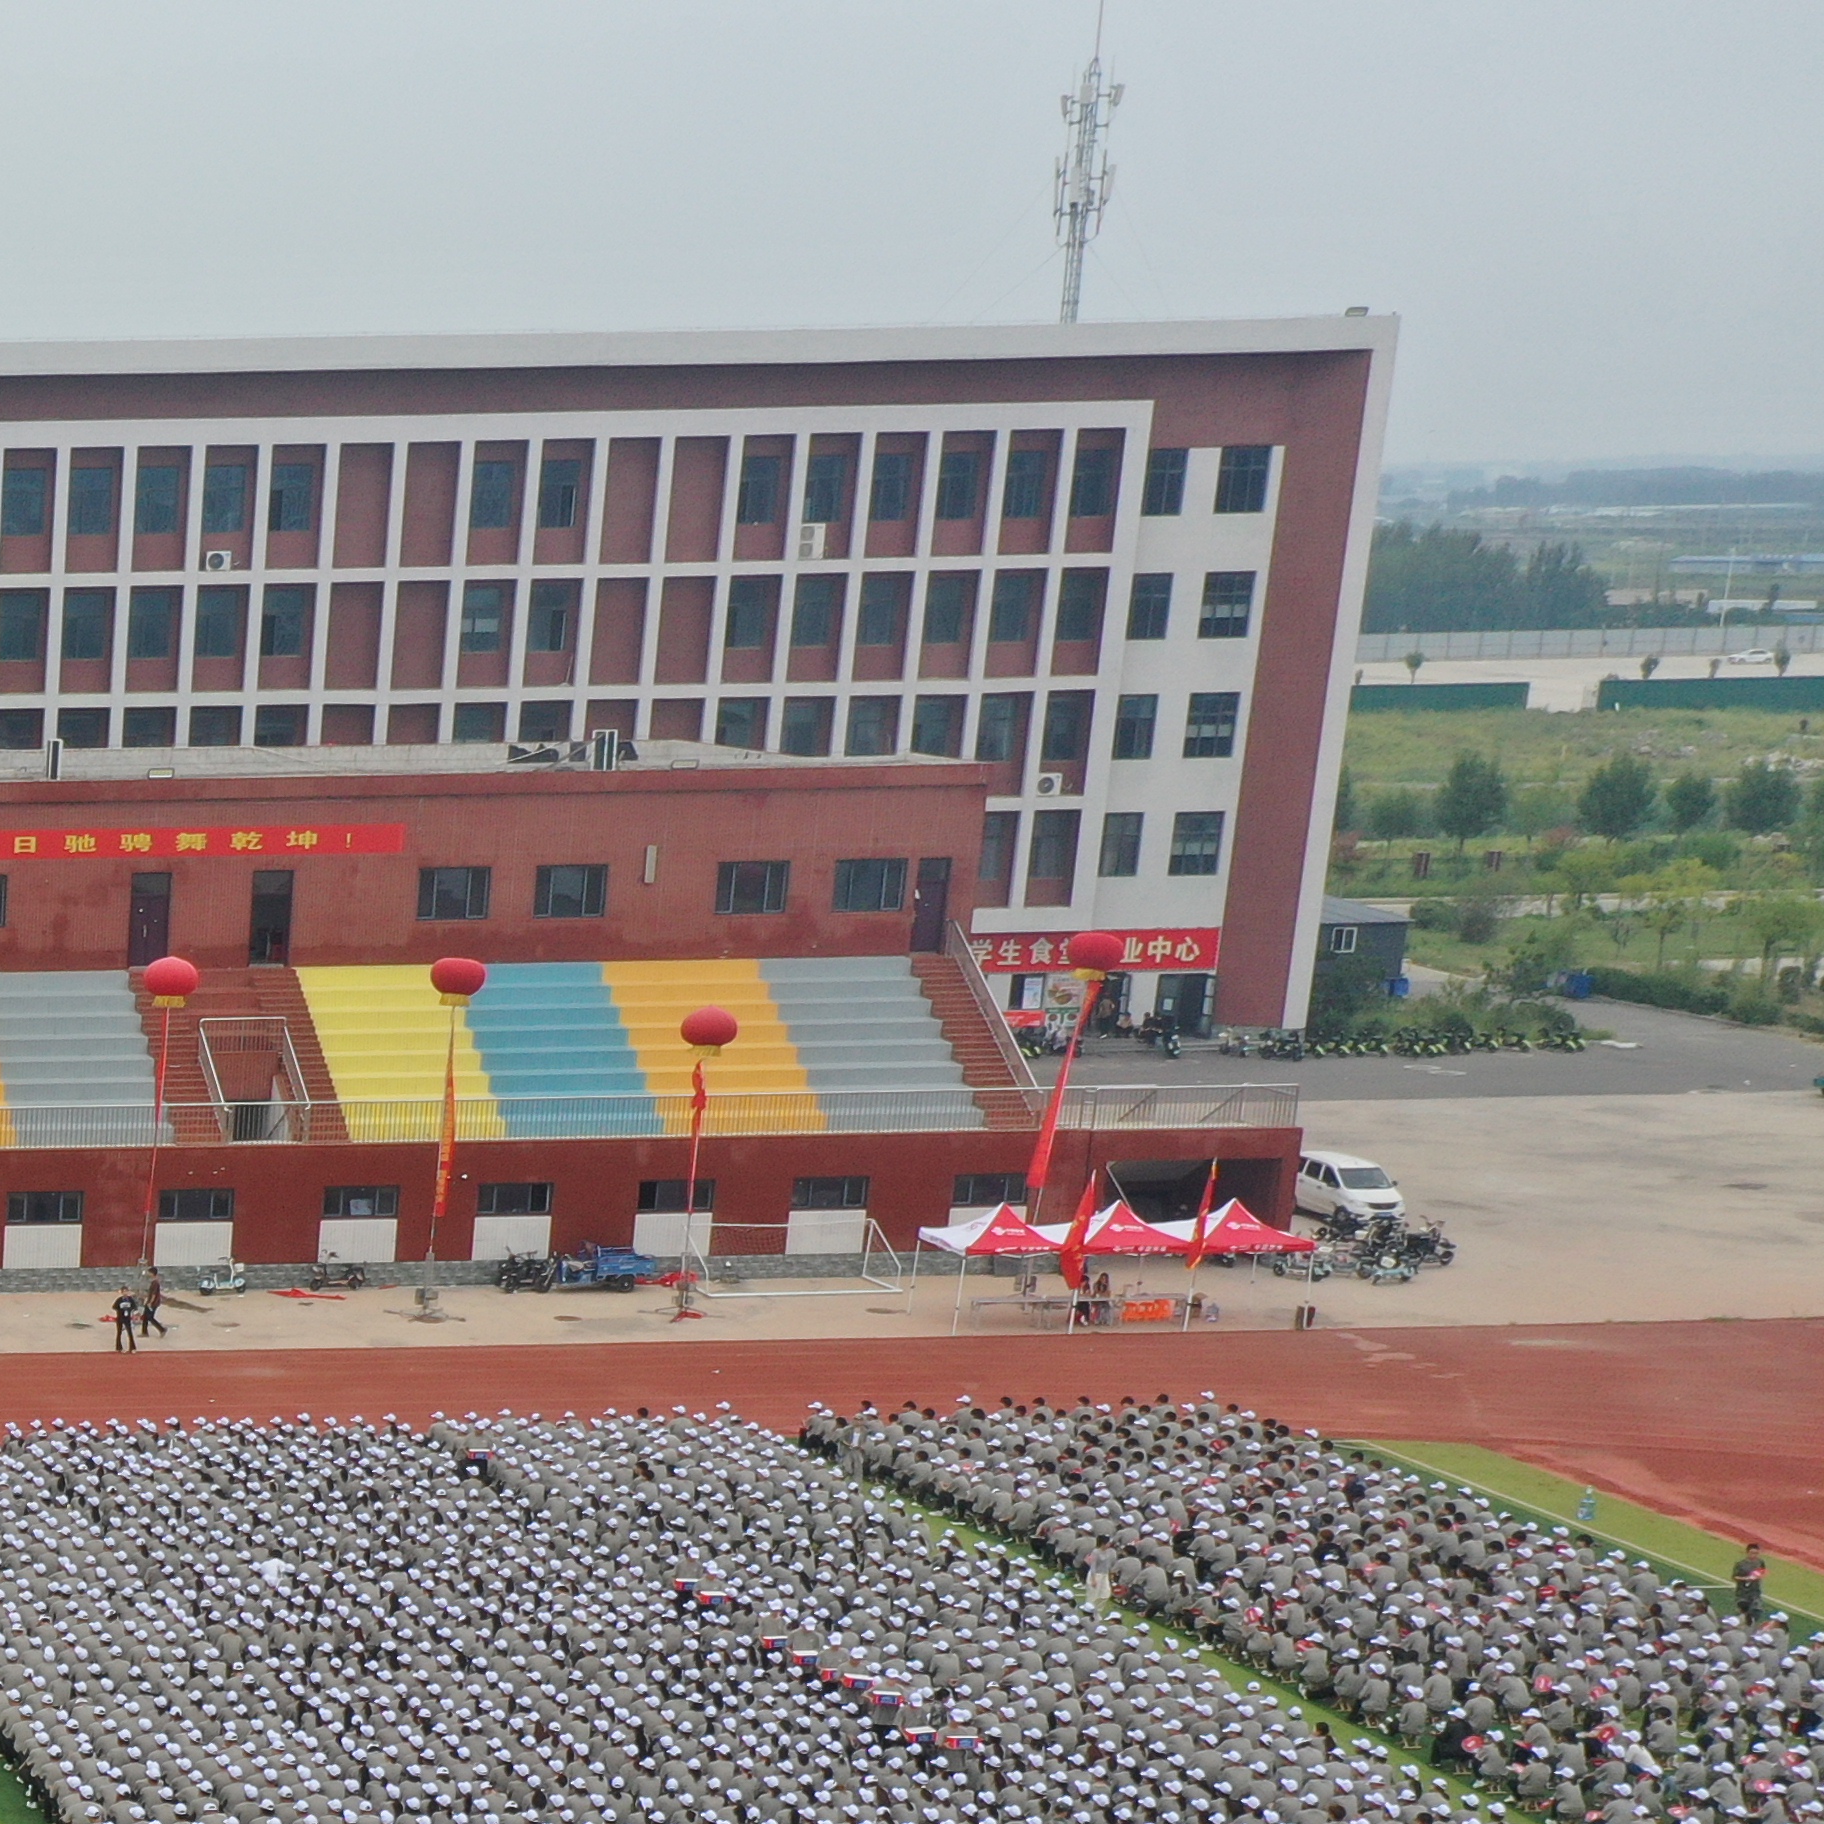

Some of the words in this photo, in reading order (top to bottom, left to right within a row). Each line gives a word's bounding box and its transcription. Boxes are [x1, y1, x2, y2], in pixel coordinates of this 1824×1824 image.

[970, 936, 1200, 966] 学生食业中心
